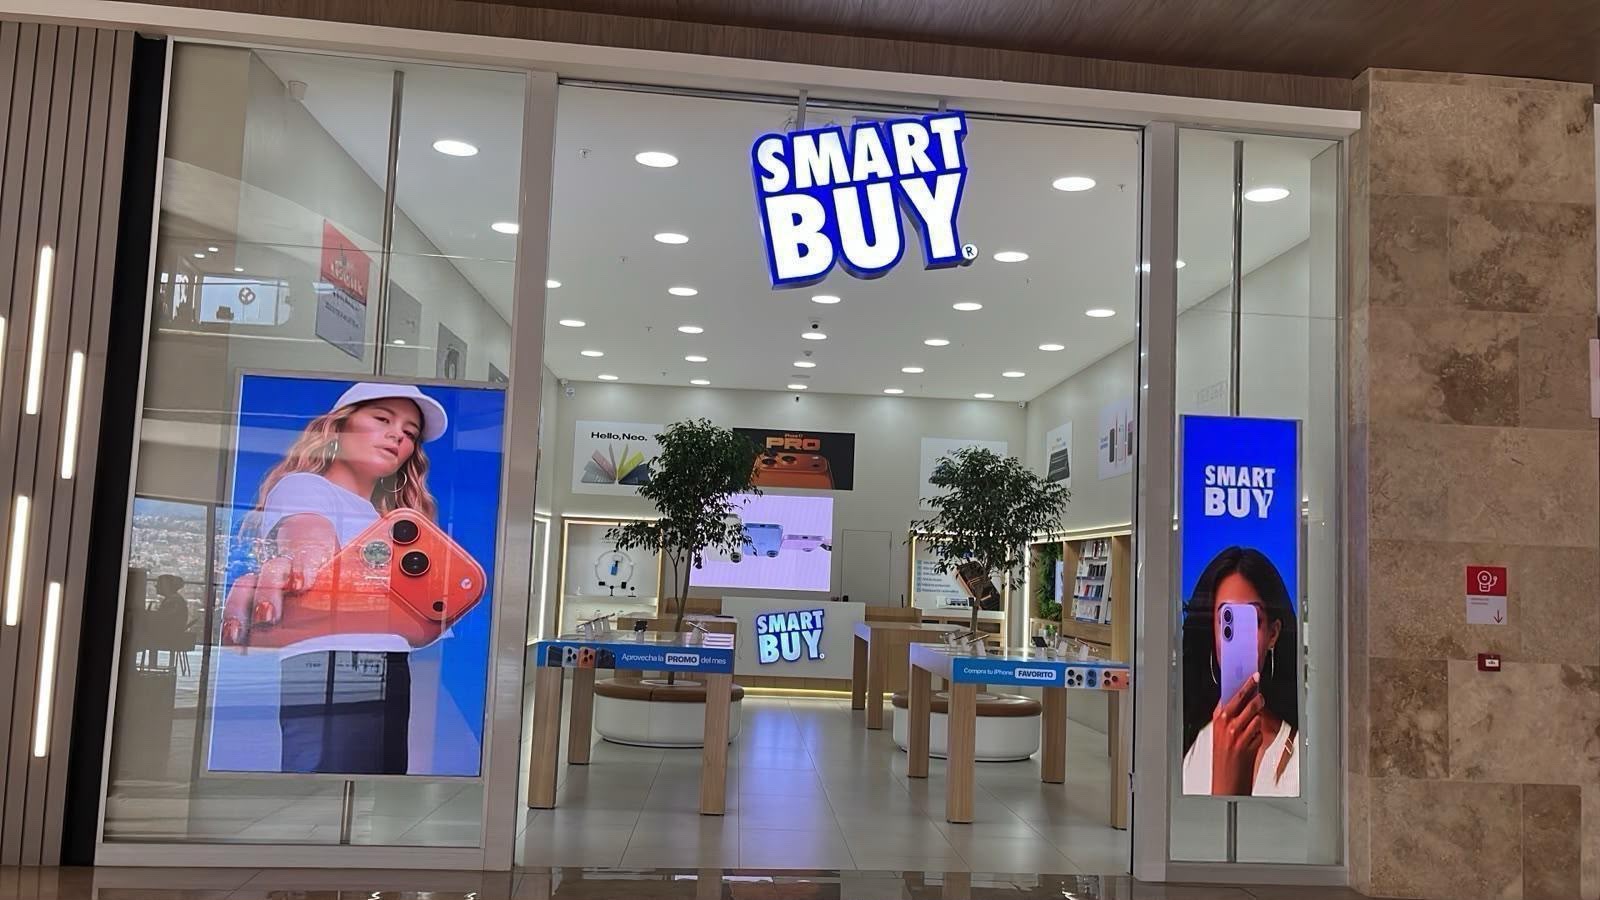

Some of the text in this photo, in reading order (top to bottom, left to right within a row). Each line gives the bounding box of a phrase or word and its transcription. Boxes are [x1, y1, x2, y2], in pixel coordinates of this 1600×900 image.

[757, 117, 962, 193] SMART
[766, 437, 821, 451] PRO
[1205, 464, 1276, 488] SMART
[1204, 487, 1274, 519] BUY
[757, 610, 823, 634] SMART
[621, 653, 657, 662] Aprovecha
[667, 655, 698, 664] PROMO
[700, 656, 711, 664] del
[1018, 670, 1053, 678] FAVORITO
